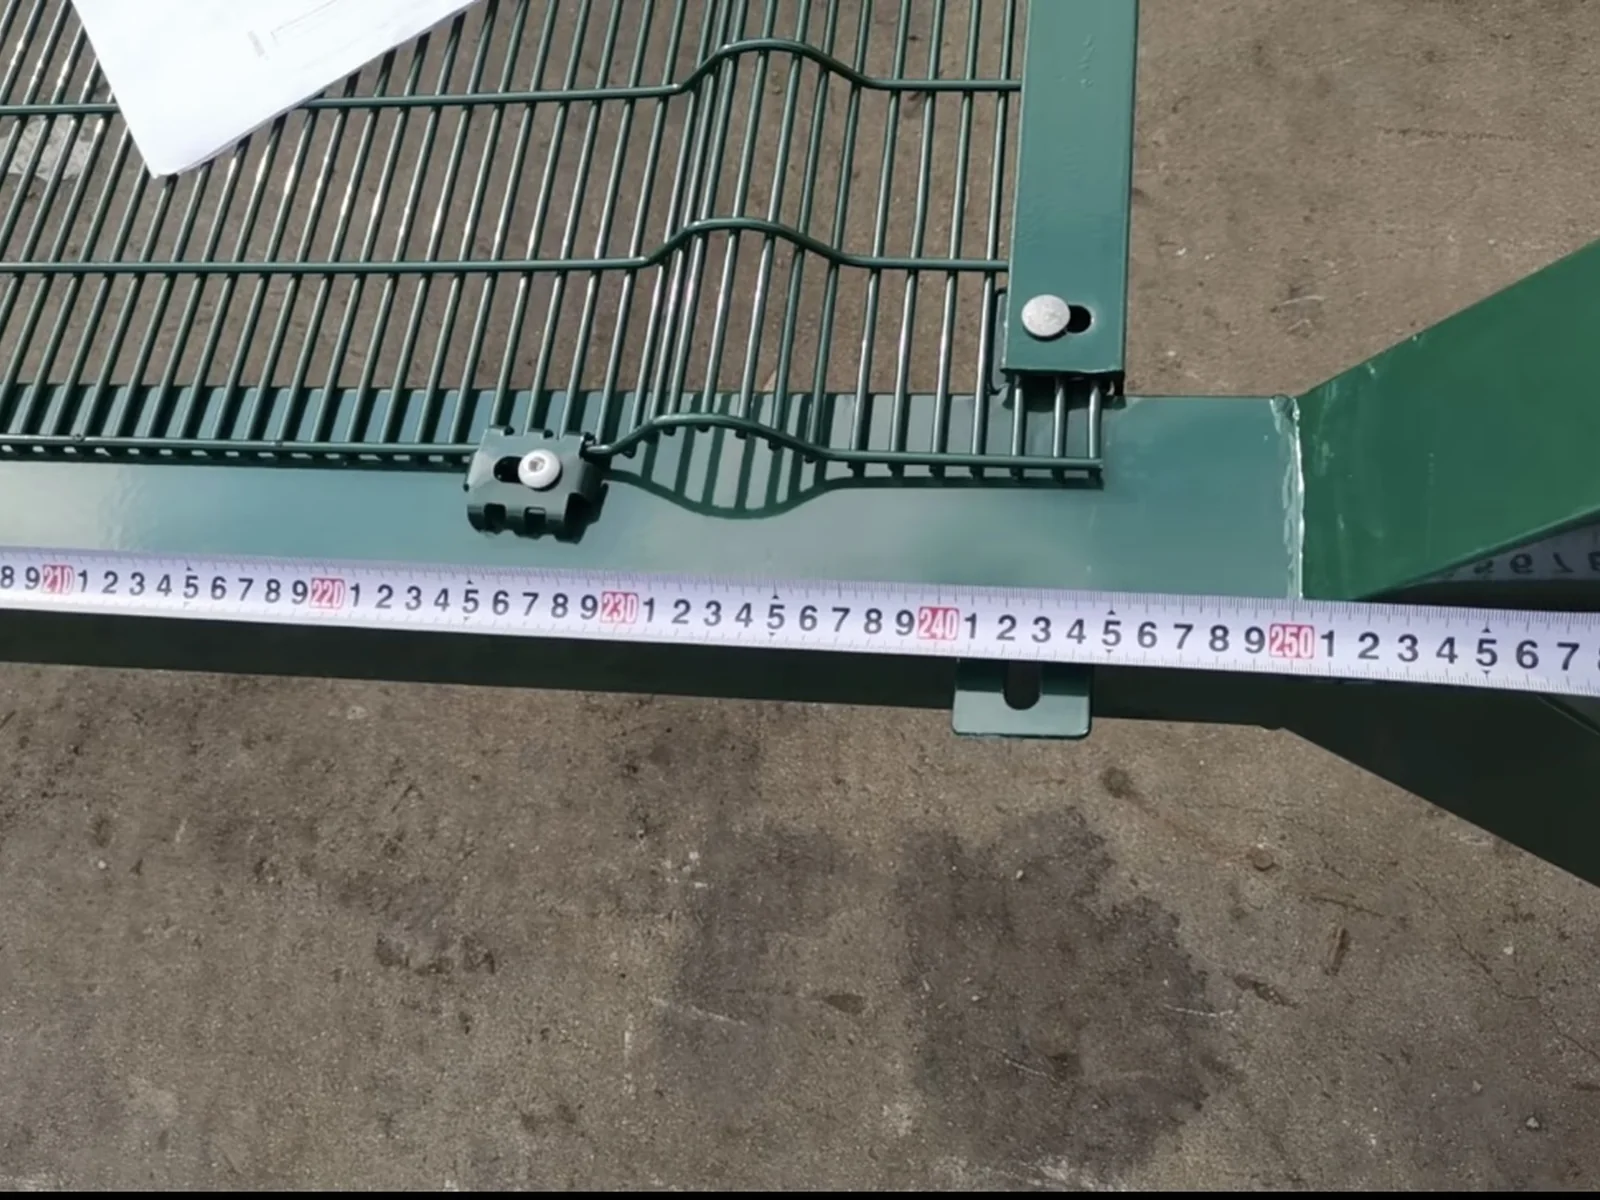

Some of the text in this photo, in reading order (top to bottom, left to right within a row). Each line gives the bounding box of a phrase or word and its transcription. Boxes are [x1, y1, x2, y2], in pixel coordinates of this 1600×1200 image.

[0, 565, 15, 588] 8
[24, 566, 40, 588] 9
[43, 566, 72, 594] 210
[77, 569, 88, 591] 1
[103, 570, 119, 592] 2
[129, 571, 145, 593] 3
[156, 574, 171, 596] 4
[184, 575, 199, 597] 5
[210, 575, 226, 598] 6
[237, 577, 254, 600] 7
[264, 578, 281, 601] 8
[291, 579, 308, 602] 9
[312, 579, 343, 608] 220
[349, 583, 360, 606] 1
[376, 583, 394, 606] 2
[405, 585, 422, 609] 3
[433, 588, 449, 612] 4
[463, 588, 479, 612] 5
[491, 589, 509, 613] 6
[521, 591, 539, 615] 7
[551, 592, 569, 617] 8
[579, 594, 598, 618] 9
[603, 594, 637, 623] 230
[642, 597, 655, 622] 1
[672, 598, 691, 623] 2
[704, 600, 722, 625] 3
[734, 602, 752, 627] 4
[767, 604, 785, 629] 5
[798, 604, 818, 630] 6
[831, 606, 851, 632] 7
[864, 607, 883, 633] 8
[896, 609, 915, 633] 9
[919, 608, 958, 640] 240
[964, 612, 977, 638] 1
[997, 614, 1017, 640] 2
[1032, 616, 1051, 642] 3
[1067, 618, 1085, 644] 4
[1103, 619, 1121, 646] 5
[1138, 621, 1157, 648] 6
[1173, 623, 1194, 649] 7
[1209, 624, 1229, 652] 8
[1244, 626, 1266, 653] 9
[1271, 626, 1314, 657] 250
[1320, 630, 1335, 657] 1
[1358, 631, 1380, 660] 2
[1398, 633, 1419, 662] 3
[1436, 636, 1458, 664] 4
[1476, 637, 1498, 667] 5
[1515, 639, 1540, 670] 6
[1556, 641, 1581, 671] 7
